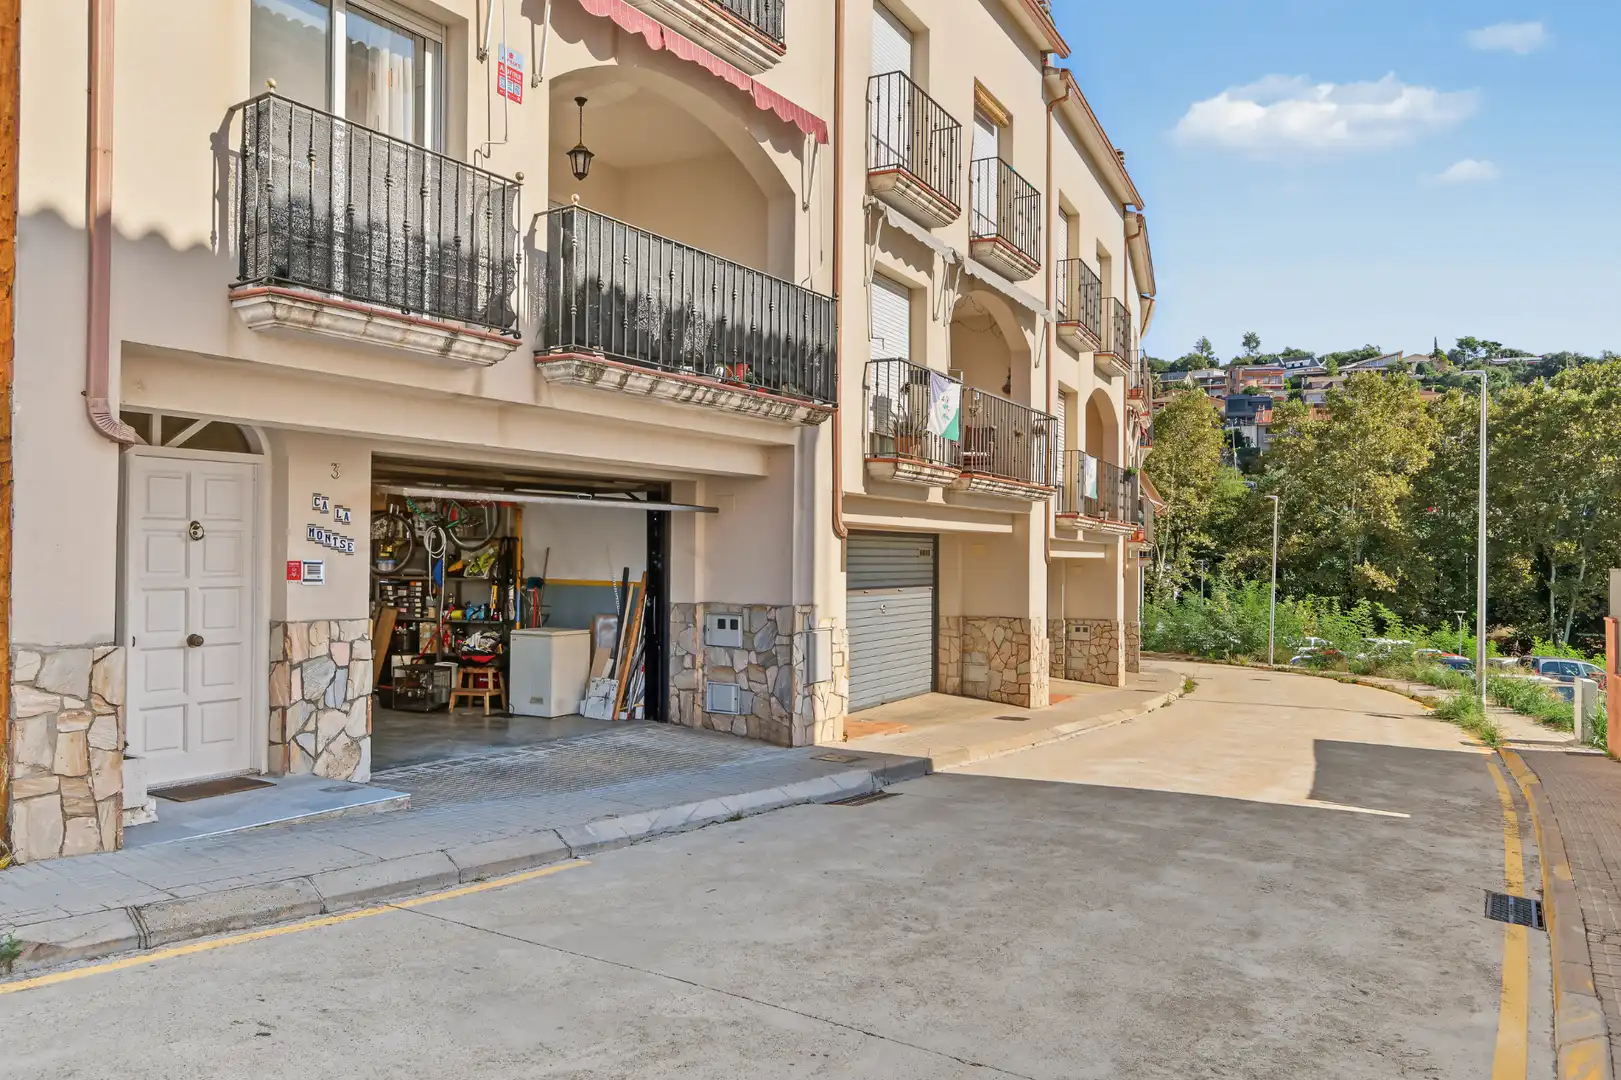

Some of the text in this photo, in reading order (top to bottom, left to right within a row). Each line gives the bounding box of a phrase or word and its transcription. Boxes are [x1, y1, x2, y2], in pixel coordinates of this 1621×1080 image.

[330, 462, 341, 480] 3
[314, 497, 349, 522] CA LA
[308, 527, 353, 552] MONTSE
